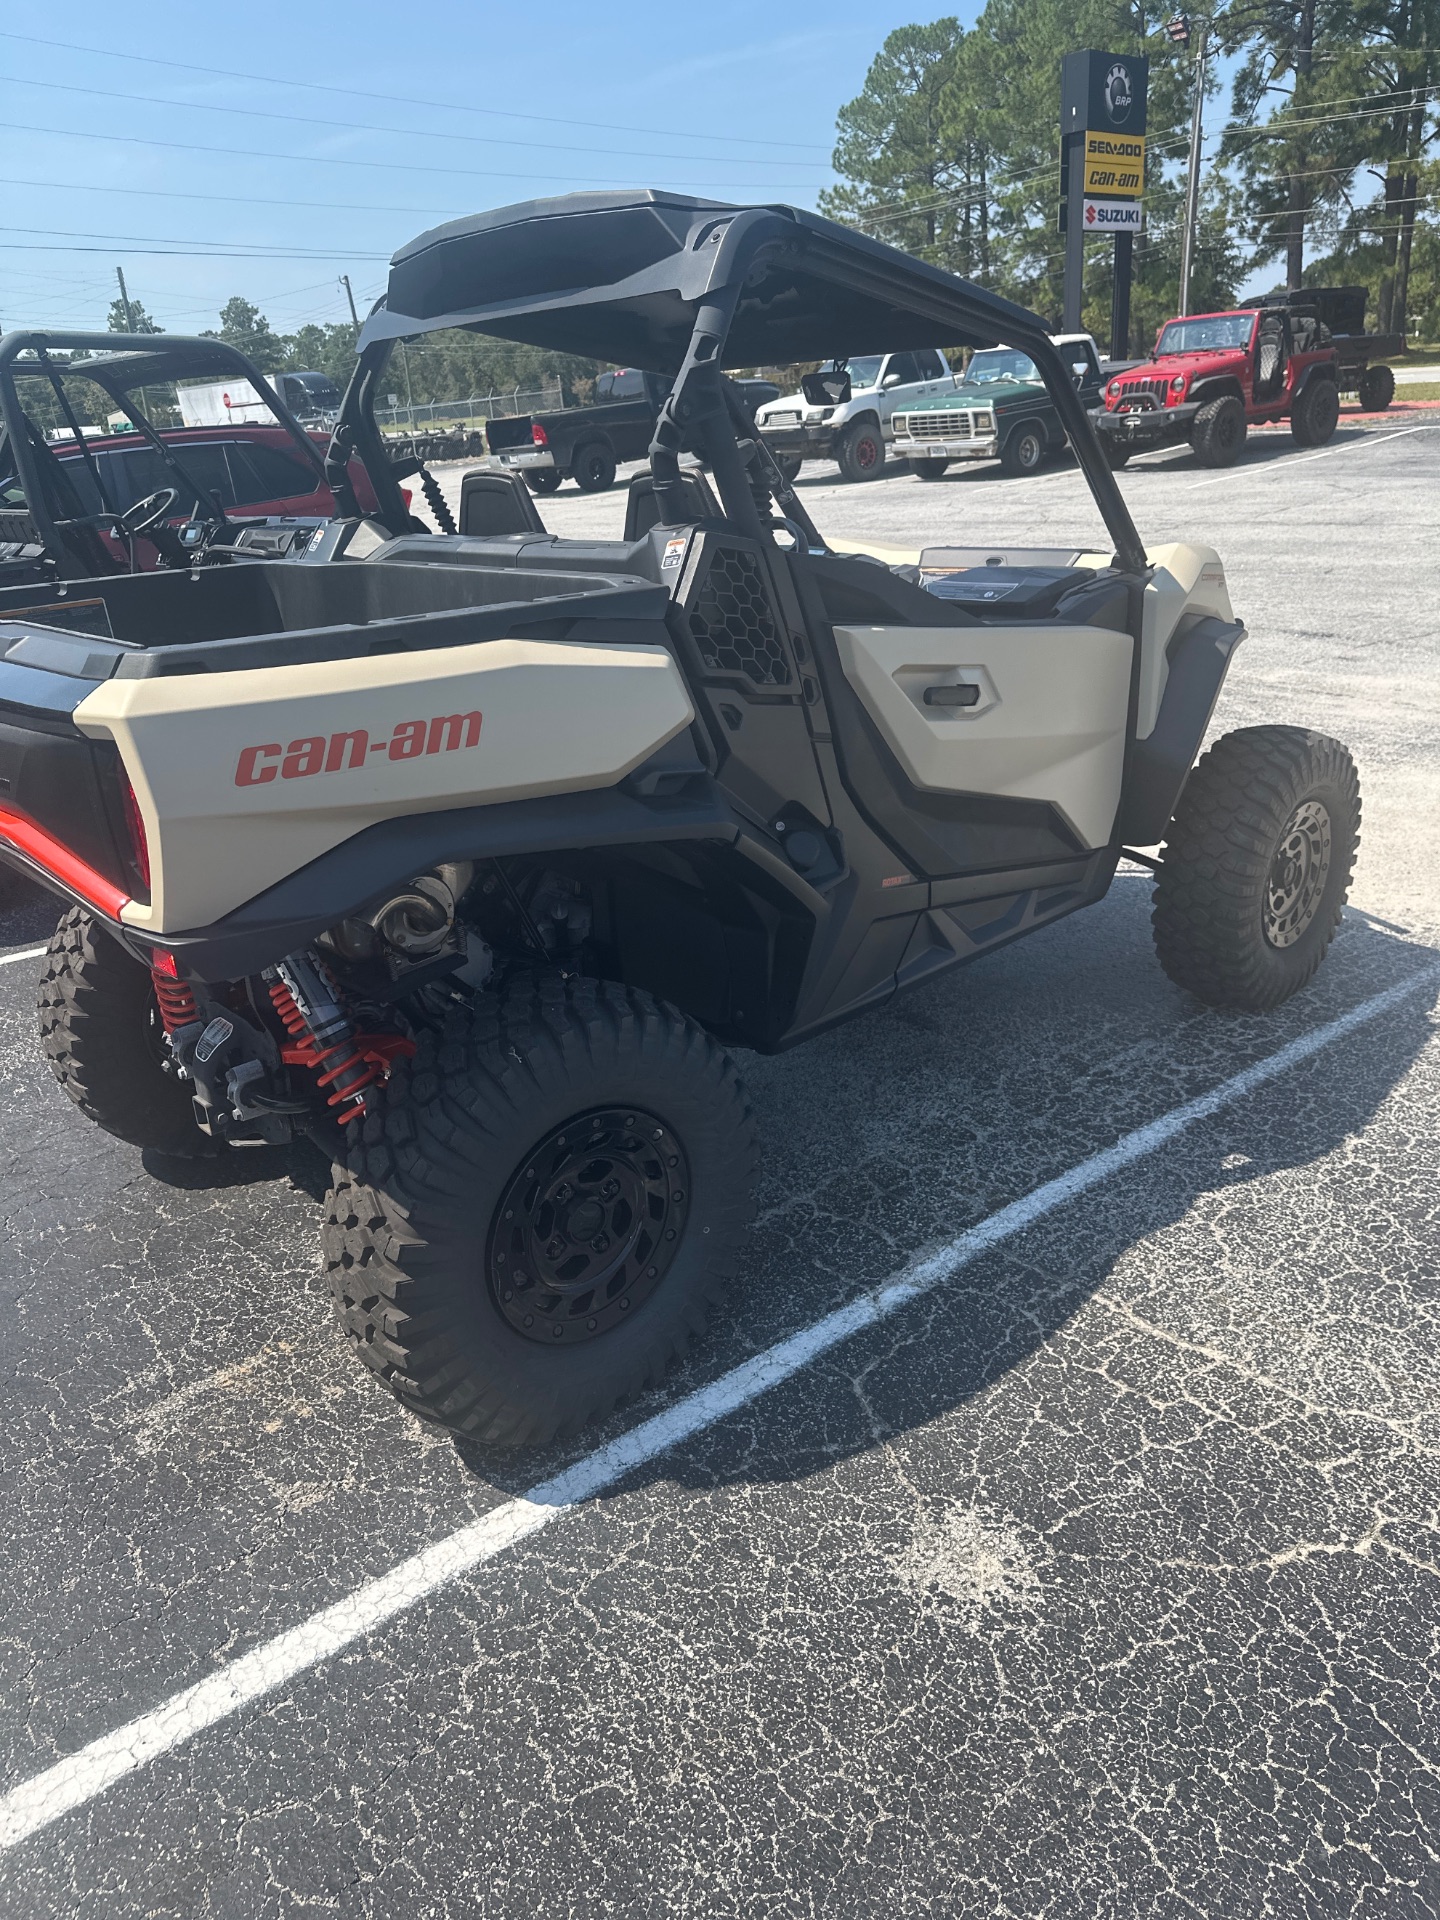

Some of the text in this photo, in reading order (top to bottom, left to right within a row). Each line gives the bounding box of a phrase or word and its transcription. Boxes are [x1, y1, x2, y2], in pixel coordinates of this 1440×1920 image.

[1115, 95, 1132, 106] BRP
[1097, 208, 1139, 223] SUZUKI
[234, 711, 483, 787] can-am
